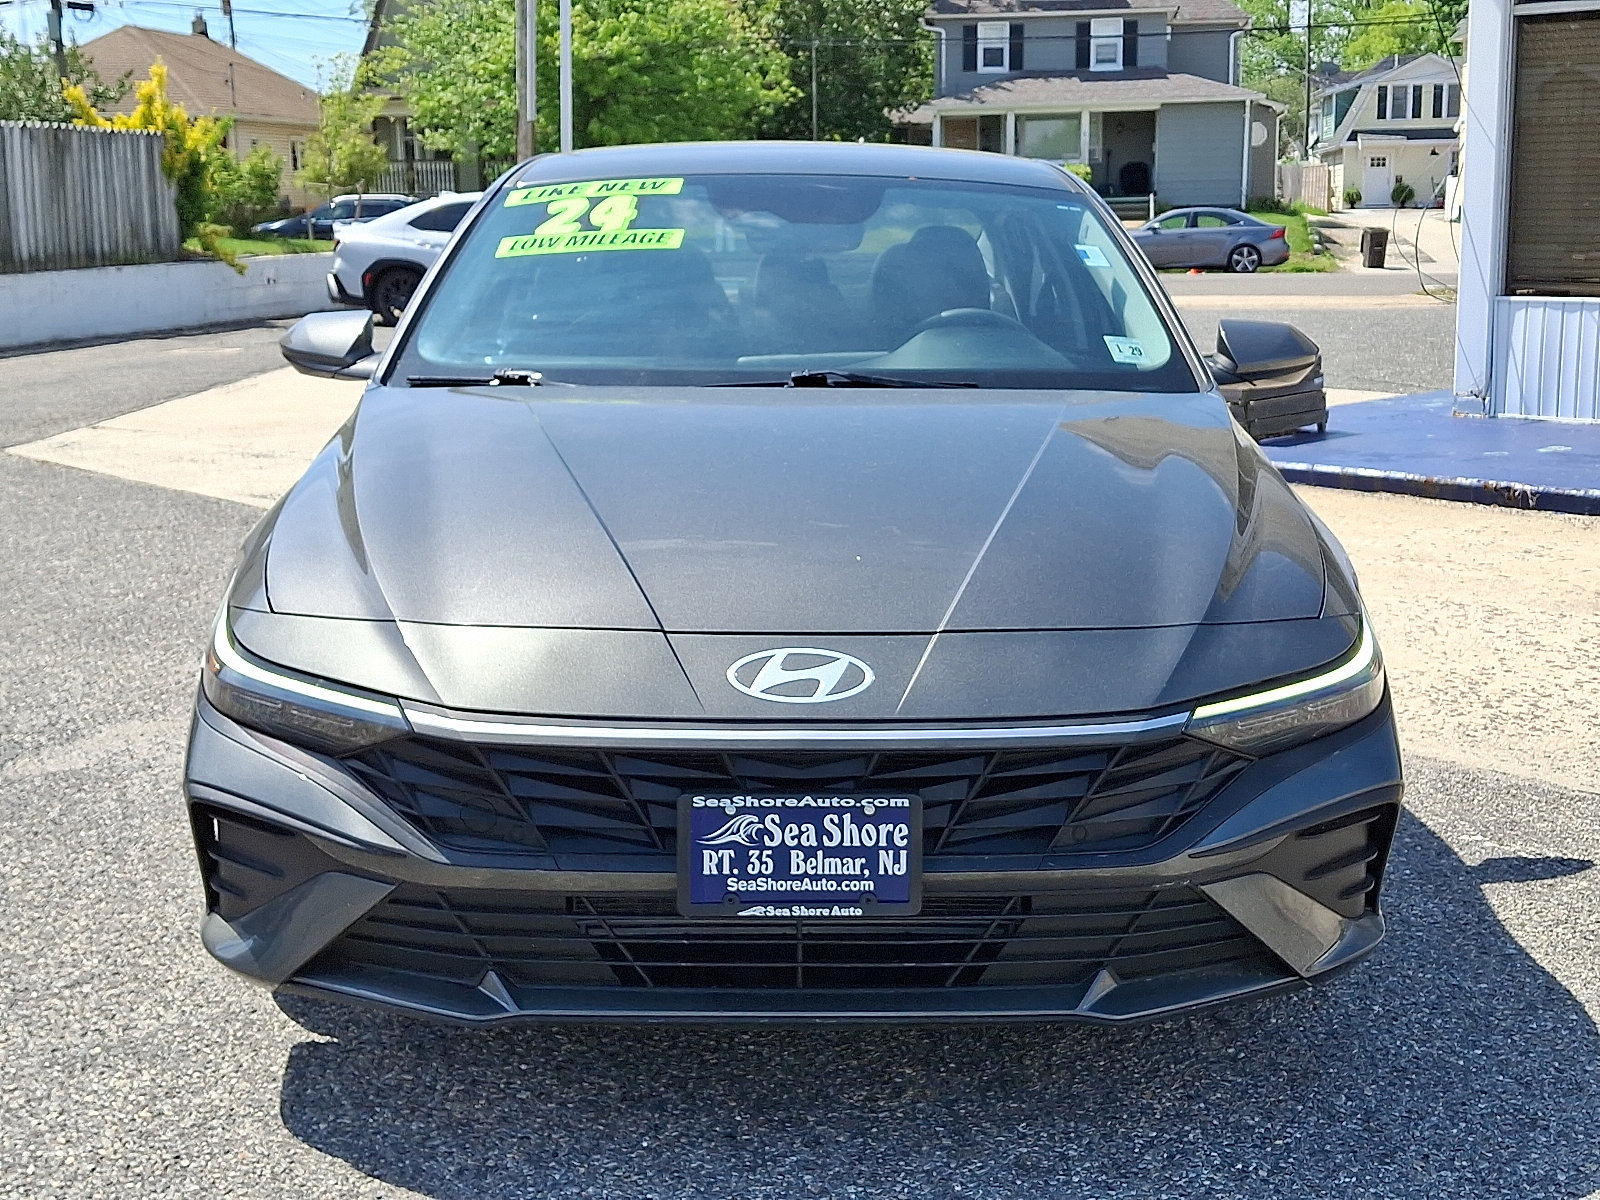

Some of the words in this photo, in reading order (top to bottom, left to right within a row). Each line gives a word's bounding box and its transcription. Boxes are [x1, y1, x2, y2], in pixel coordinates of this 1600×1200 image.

[522, 185, 580, 200] LIKE
[597, 181, 667, 192] NEW
[534, 195, 638, 235] 24
[509, 236, 561, 250] LOW
[564, 232, 673, 247] MILEAGE
[692, 795, 910, 808] SeaShoreAuto.com
[762, 813, 818, 847] Sea
[822, 812, 909, 847] Shore
[702, 849, 739, 875] RT.
[746, 849, 774, 875] 35
[789, 849, 870, 878] Belmar,
[878, 849, 908, 875] NJ
[726, 877, 874, 891] SeaShoreAuto.com
[765, 905, 790, 916] Sea
[791, 905, 830, 916] Shore
[830, 905, 863, 916] Auto
